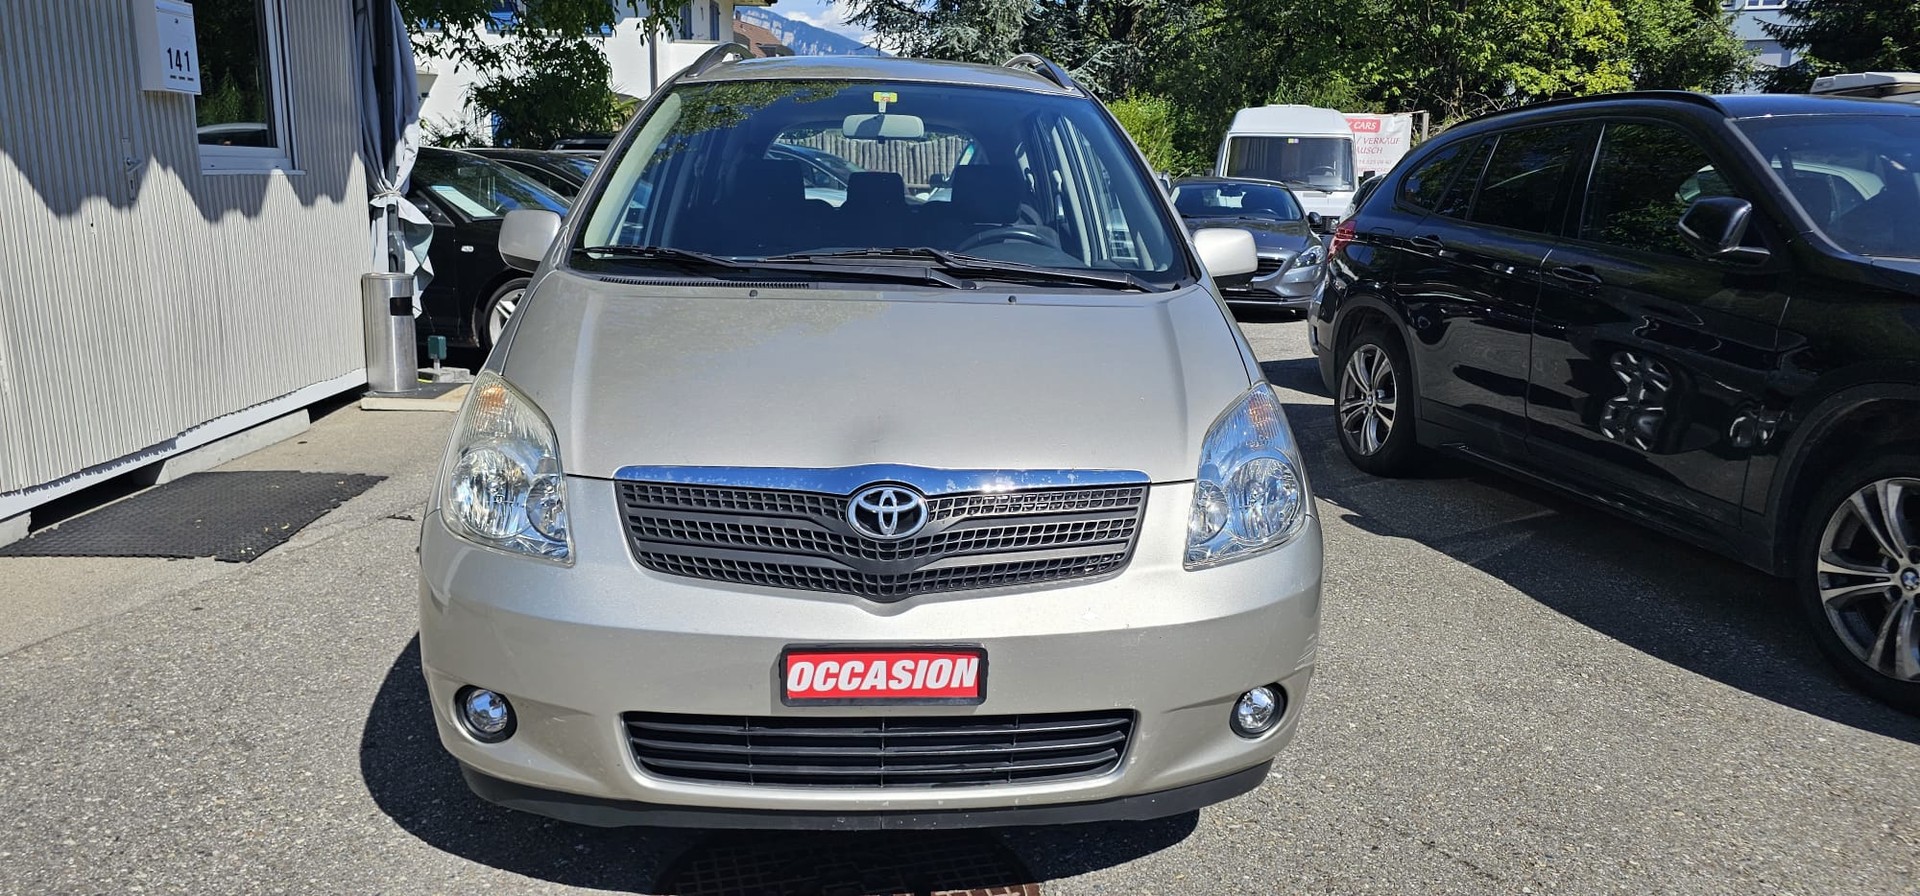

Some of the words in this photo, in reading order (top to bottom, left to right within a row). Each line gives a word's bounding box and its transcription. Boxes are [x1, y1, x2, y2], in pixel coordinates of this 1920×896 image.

[167, 47, 191, 72] 141
[1353, 121, 1377, 130] CARS
[1363, 137, 1400, 145] VERKAUF
[787, 658, 979, 692] OCCASION
